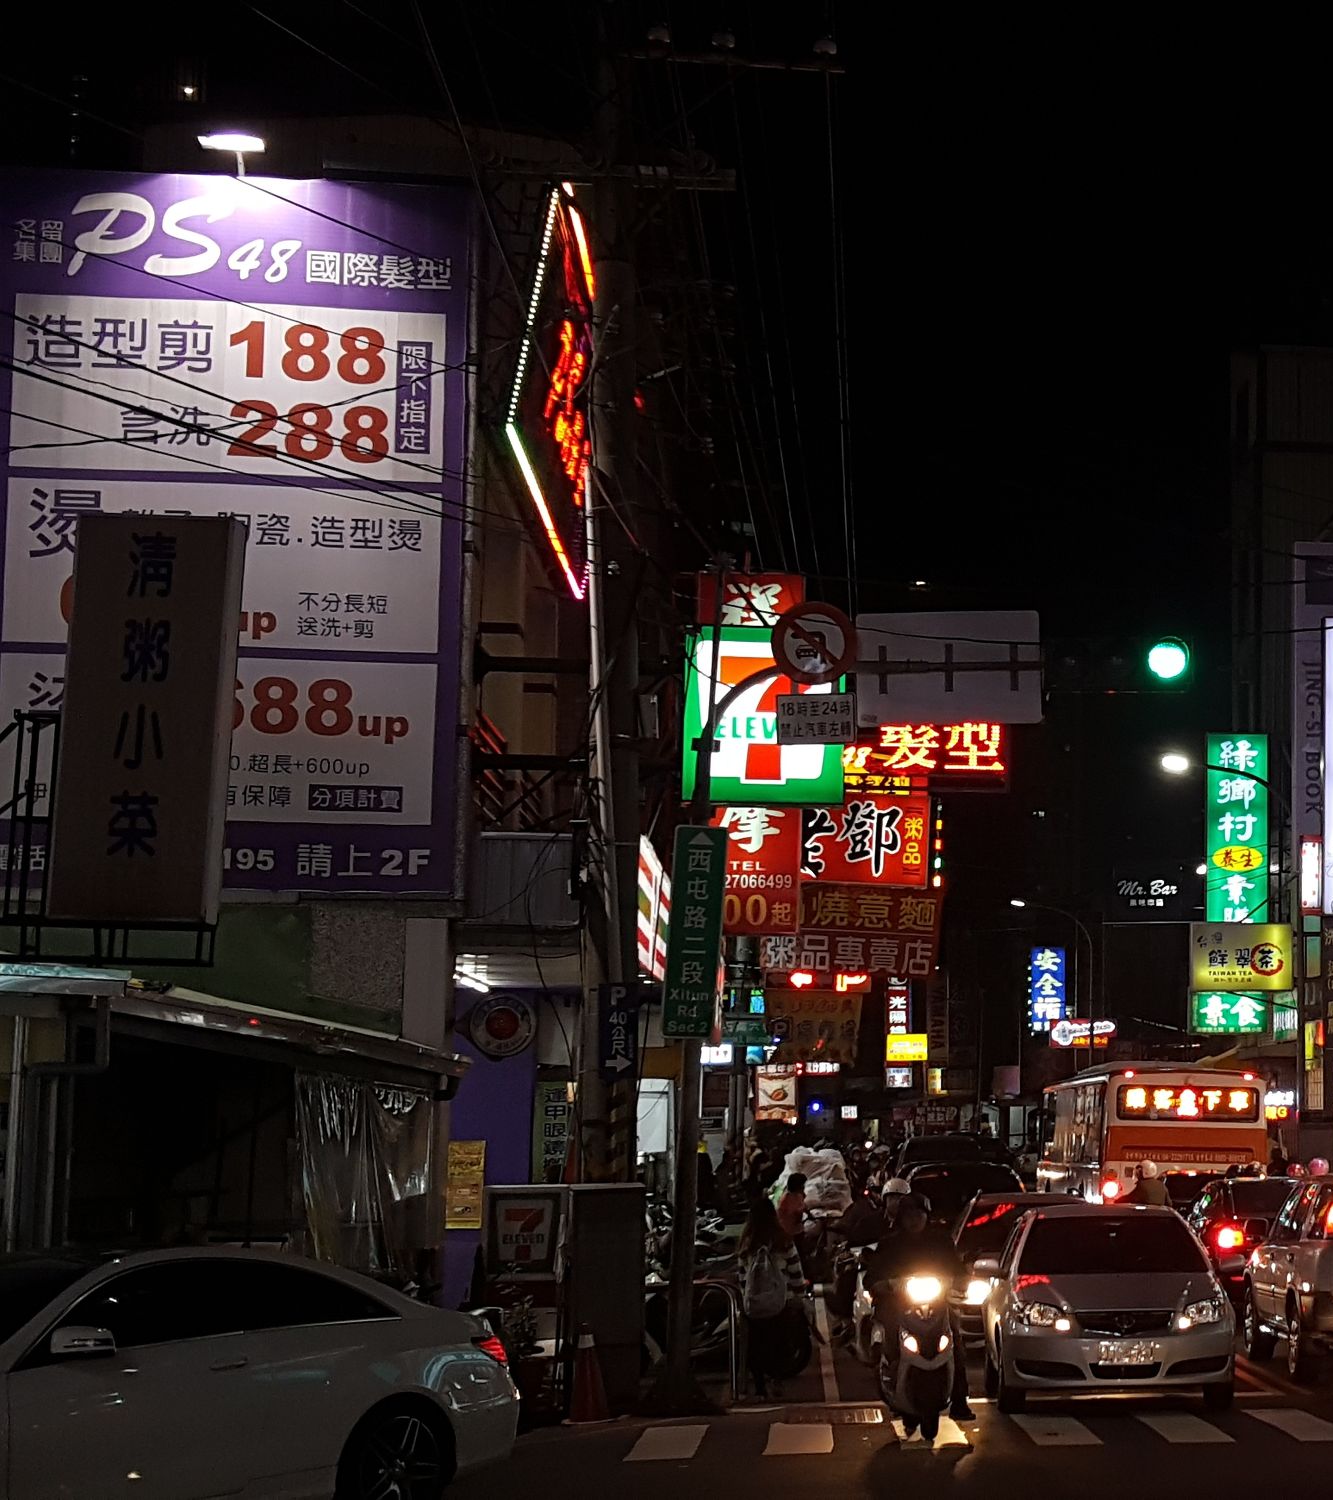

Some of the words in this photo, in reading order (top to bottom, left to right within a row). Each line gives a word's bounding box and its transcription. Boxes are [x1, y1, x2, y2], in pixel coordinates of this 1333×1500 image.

[306, 250, 452, 291] 國際髮型
[26, 313, 215, 374] 造型剪
[229, 320, 387, 385] 188
[227, 399, 390, 464] 288
[298, 592, 388, 616] 不分長短
[297, 616, 375, 640] 送洗+剪
[107, 531, 177, 858] 清粥小菜
[357, 718, 410, 745] up
[880, 723, 1005, 771] 髮型
[310, 788, 401, 811] 分項計費
[903, 817, 923, 866] 粥品
[296, 843, 432, 878] 請上2F
[729, 861, 767, 872] TEL
[1150, 879, 1178, 896] Bar
[680, 849, 713, 986] 西屯路二段
[800, 890, 937, 930] 燒意麵
[765, 934, 933, 976] 粥品專賣店
[609, 986, 627, 1006] P
[677, 1005, 698, 1018] Rd
[1200, 994, 1266, 1027] 素食
[608, 1011, 628, 1025] 40
